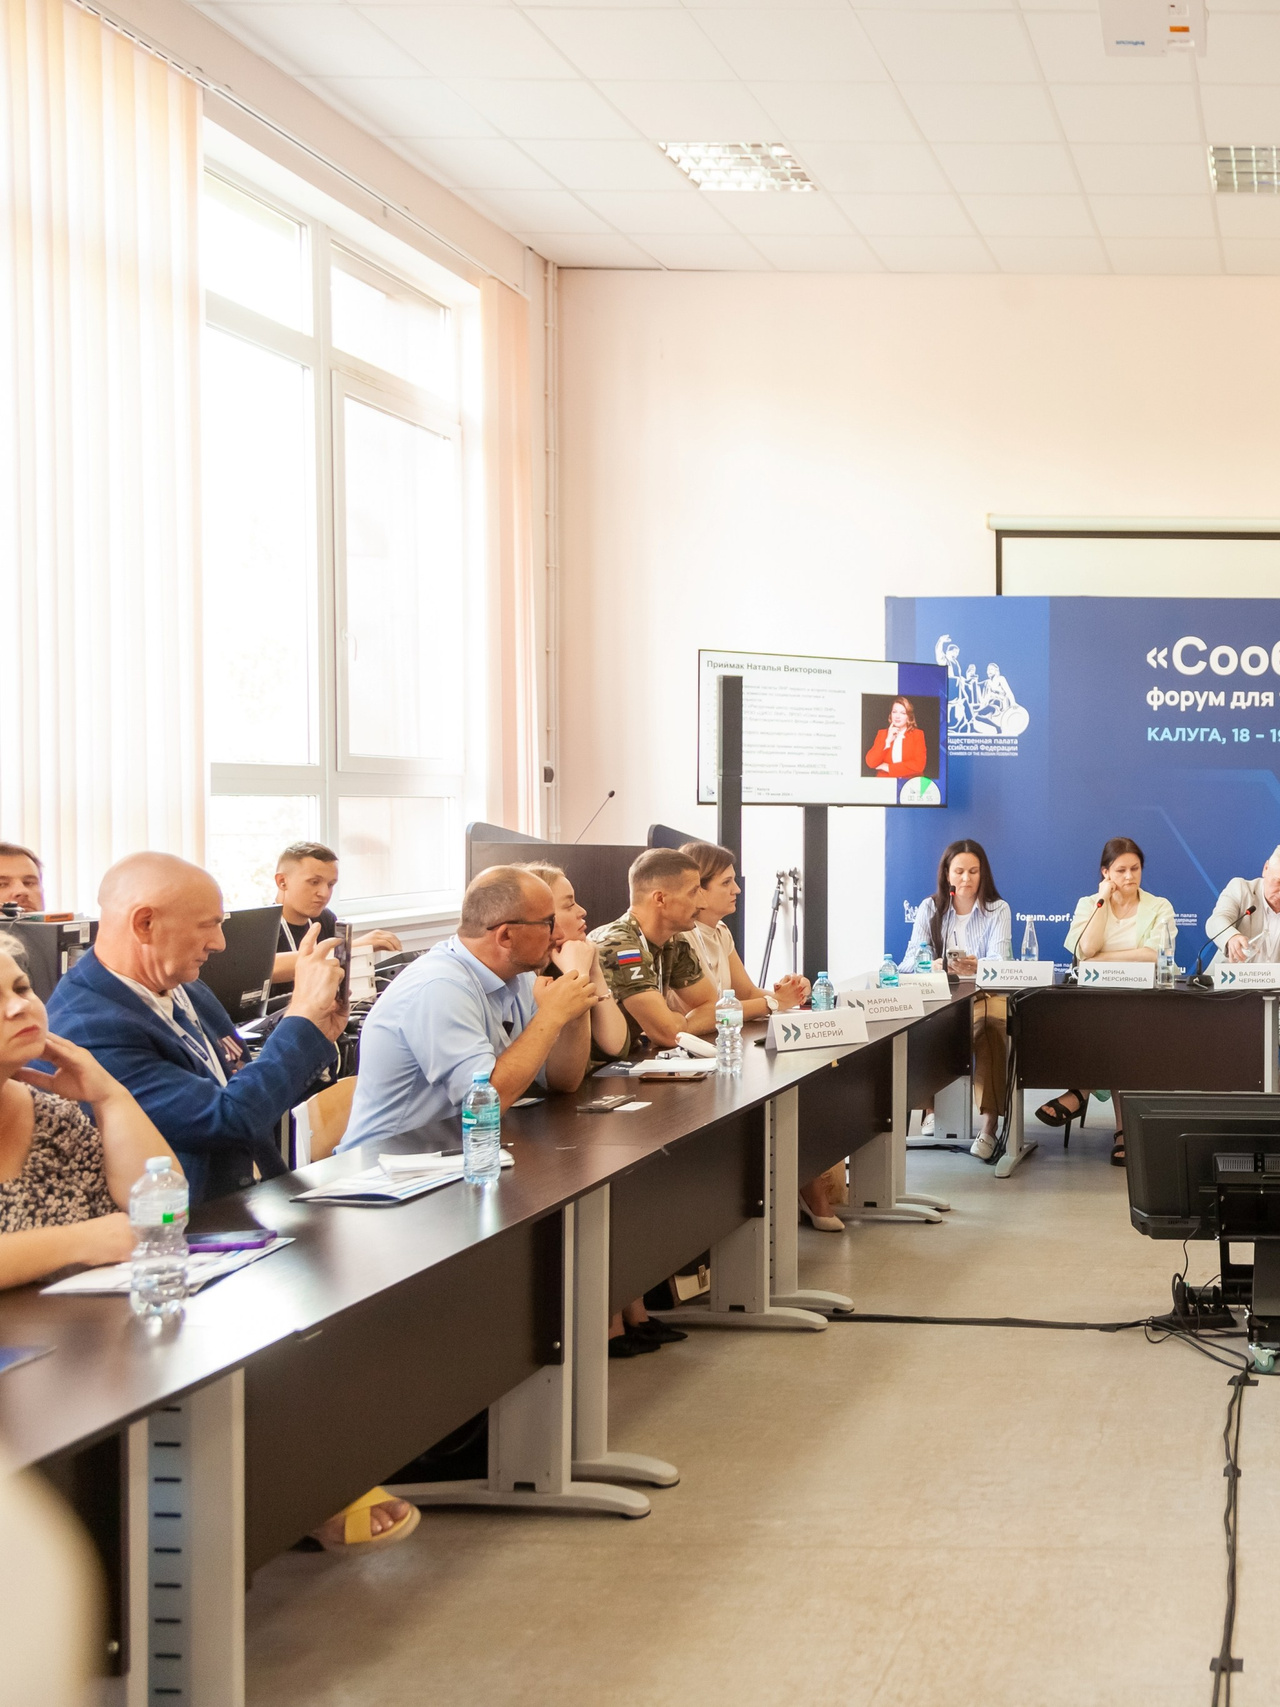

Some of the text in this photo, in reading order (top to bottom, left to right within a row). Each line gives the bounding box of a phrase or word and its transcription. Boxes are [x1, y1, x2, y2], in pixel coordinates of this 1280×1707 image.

[747, 663, 781, 671] Наталья
[784, 665, 832, 674] Викторовна
[1146, 687, 1225, 712] форум
[1230, 690, 1274, 709] для
[1147, 727, 1226, 744] КАЛУГА,
[1232, 727, 1250, 742] 18
[948, 737, 992, 745] щественная
[629, 966, 644, 980] Z
[1000, 974, 1038, 982] МУРАТОВА
[1238, 969, 1271, 977] ВАЛЕРИЙ
[867, 997, 898, 1006] МАРИНА
[868, 1004, 913, 1014] СОЛОВЬЕВА
[803, 1020, 836, 1030] ЕГОРОВ
[805, 1028, 844, 1040] ВАЛЕРИЙ
